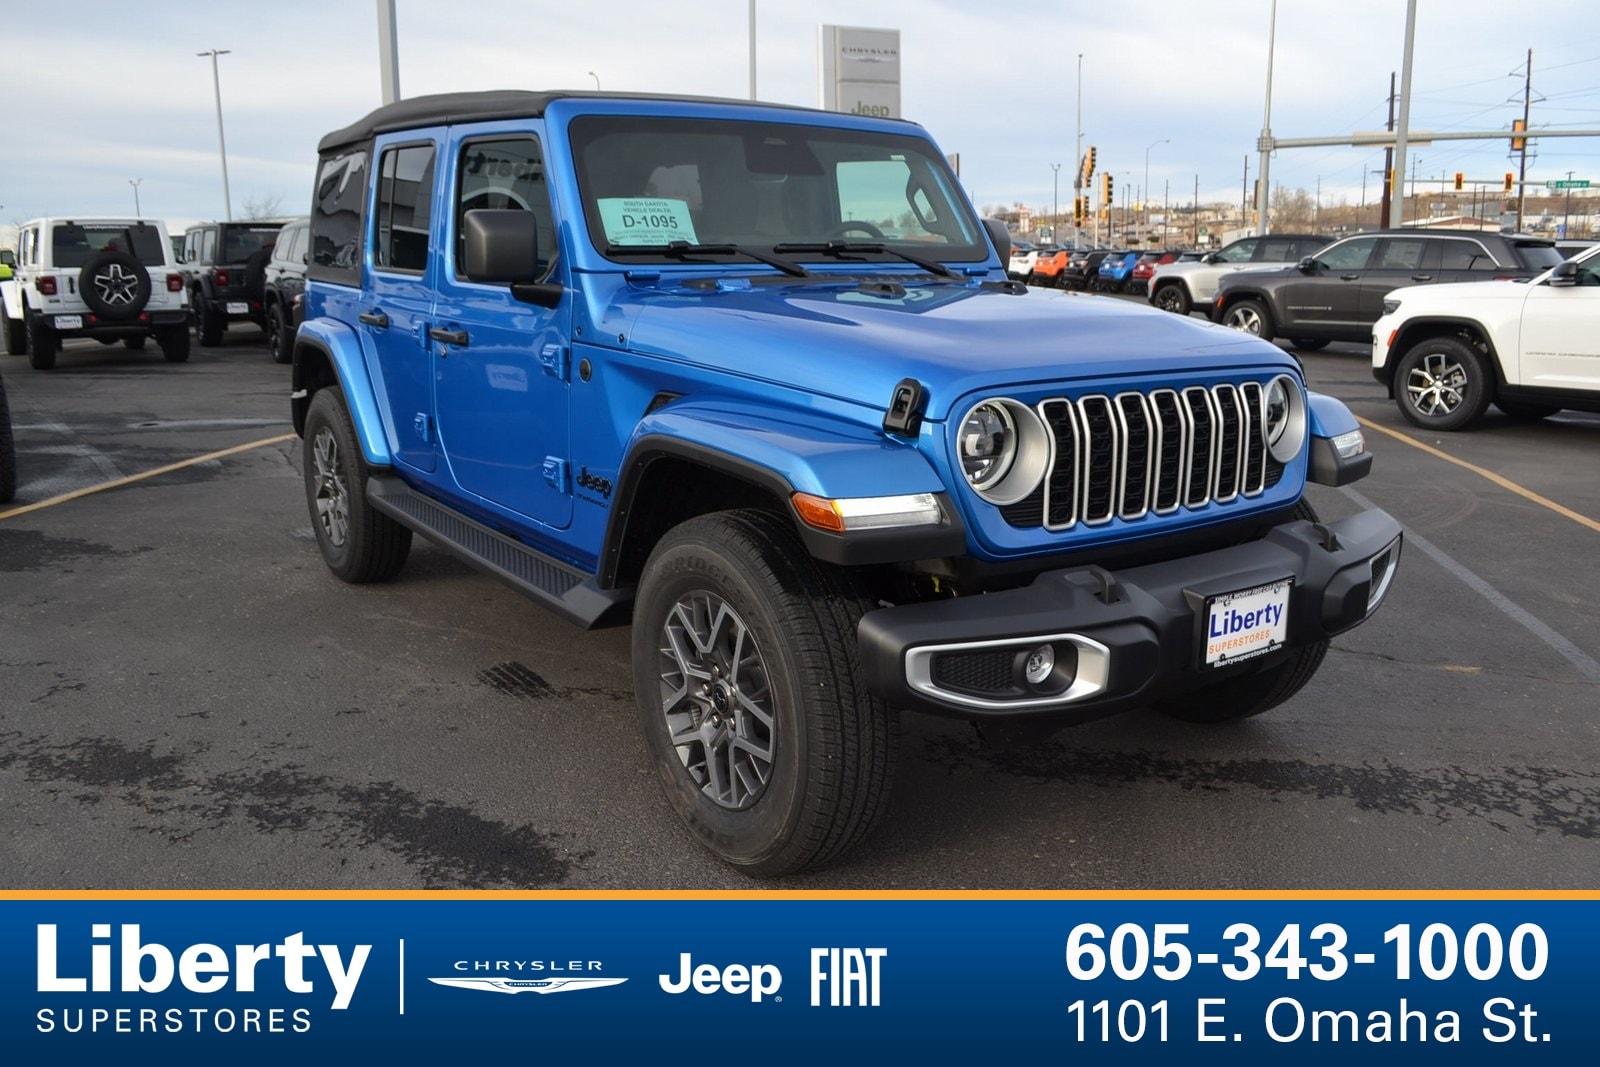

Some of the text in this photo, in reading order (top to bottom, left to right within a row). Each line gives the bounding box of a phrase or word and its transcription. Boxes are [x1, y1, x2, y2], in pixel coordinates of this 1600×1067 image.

[622, 214, 679, 229] D-1095
[576, 466, 613, 499] Jeep
[1210, 603, 1283, 638] Liberty
[1209, 630, 1271, 654] SUPERSTORES
